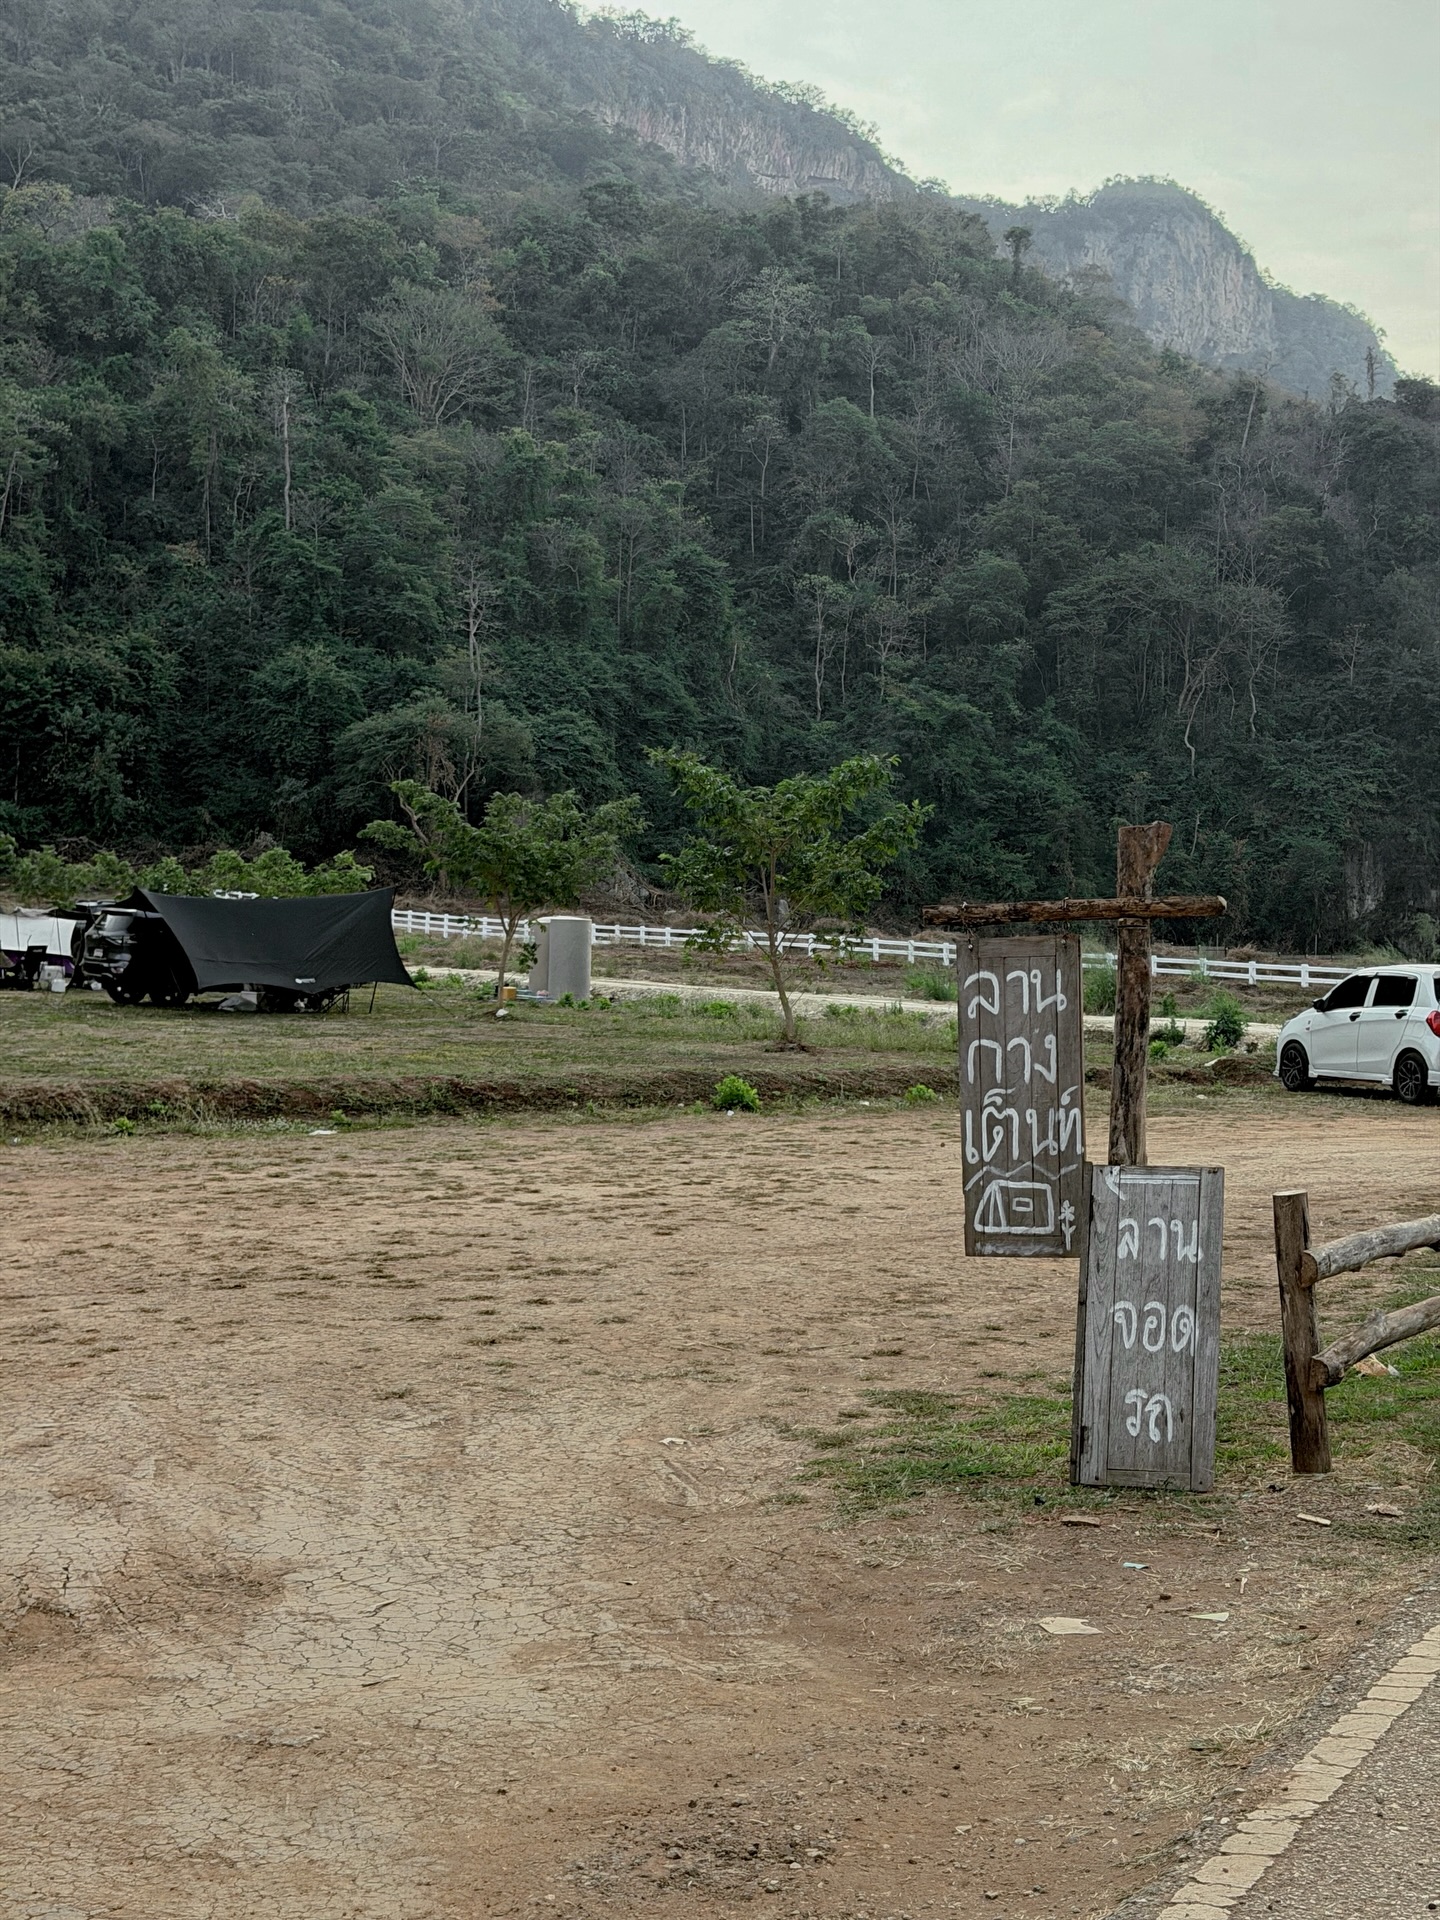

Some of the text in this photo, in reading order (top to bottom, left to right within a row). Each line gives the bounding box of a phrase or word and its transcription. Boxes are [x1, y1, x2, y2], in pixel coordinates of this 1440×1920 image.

[963, 969, 1068, 1019] ลาน
[967, 1033, 1058, 1084] กาง
[965, 1086, 1085, 1164] เต็นท์
[1118, 1217, 1204, 1263] ลาน
[1110, 1301, 1199, 1356] จอด
[1124, 1388, 1174, 1443] รถ
